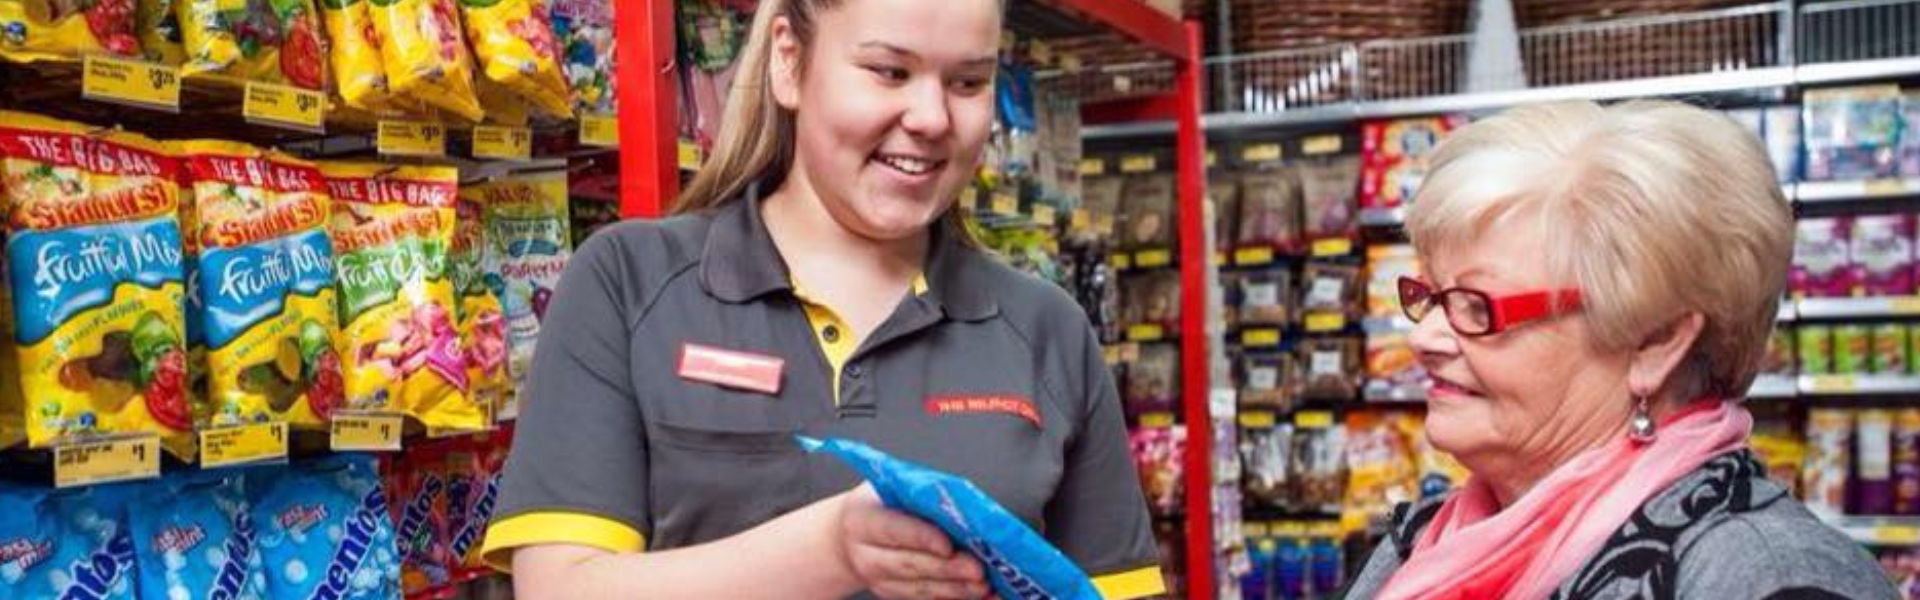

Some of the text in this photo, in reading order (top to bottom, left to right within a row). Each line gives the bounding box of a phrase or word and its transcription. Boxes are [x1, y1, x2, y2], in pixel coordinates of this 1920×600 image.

[18, 135, 161, 176] THE BIG BAG
[209, 157, 246, 183] THE
[277, 166, 311, 191] BAG
[328, 177, 441, 208] THE BIG BAG
[396, 472, 441, 557] entos
[54, 533, 137, 600] ntos
[208, 504, 258, 600] entos
